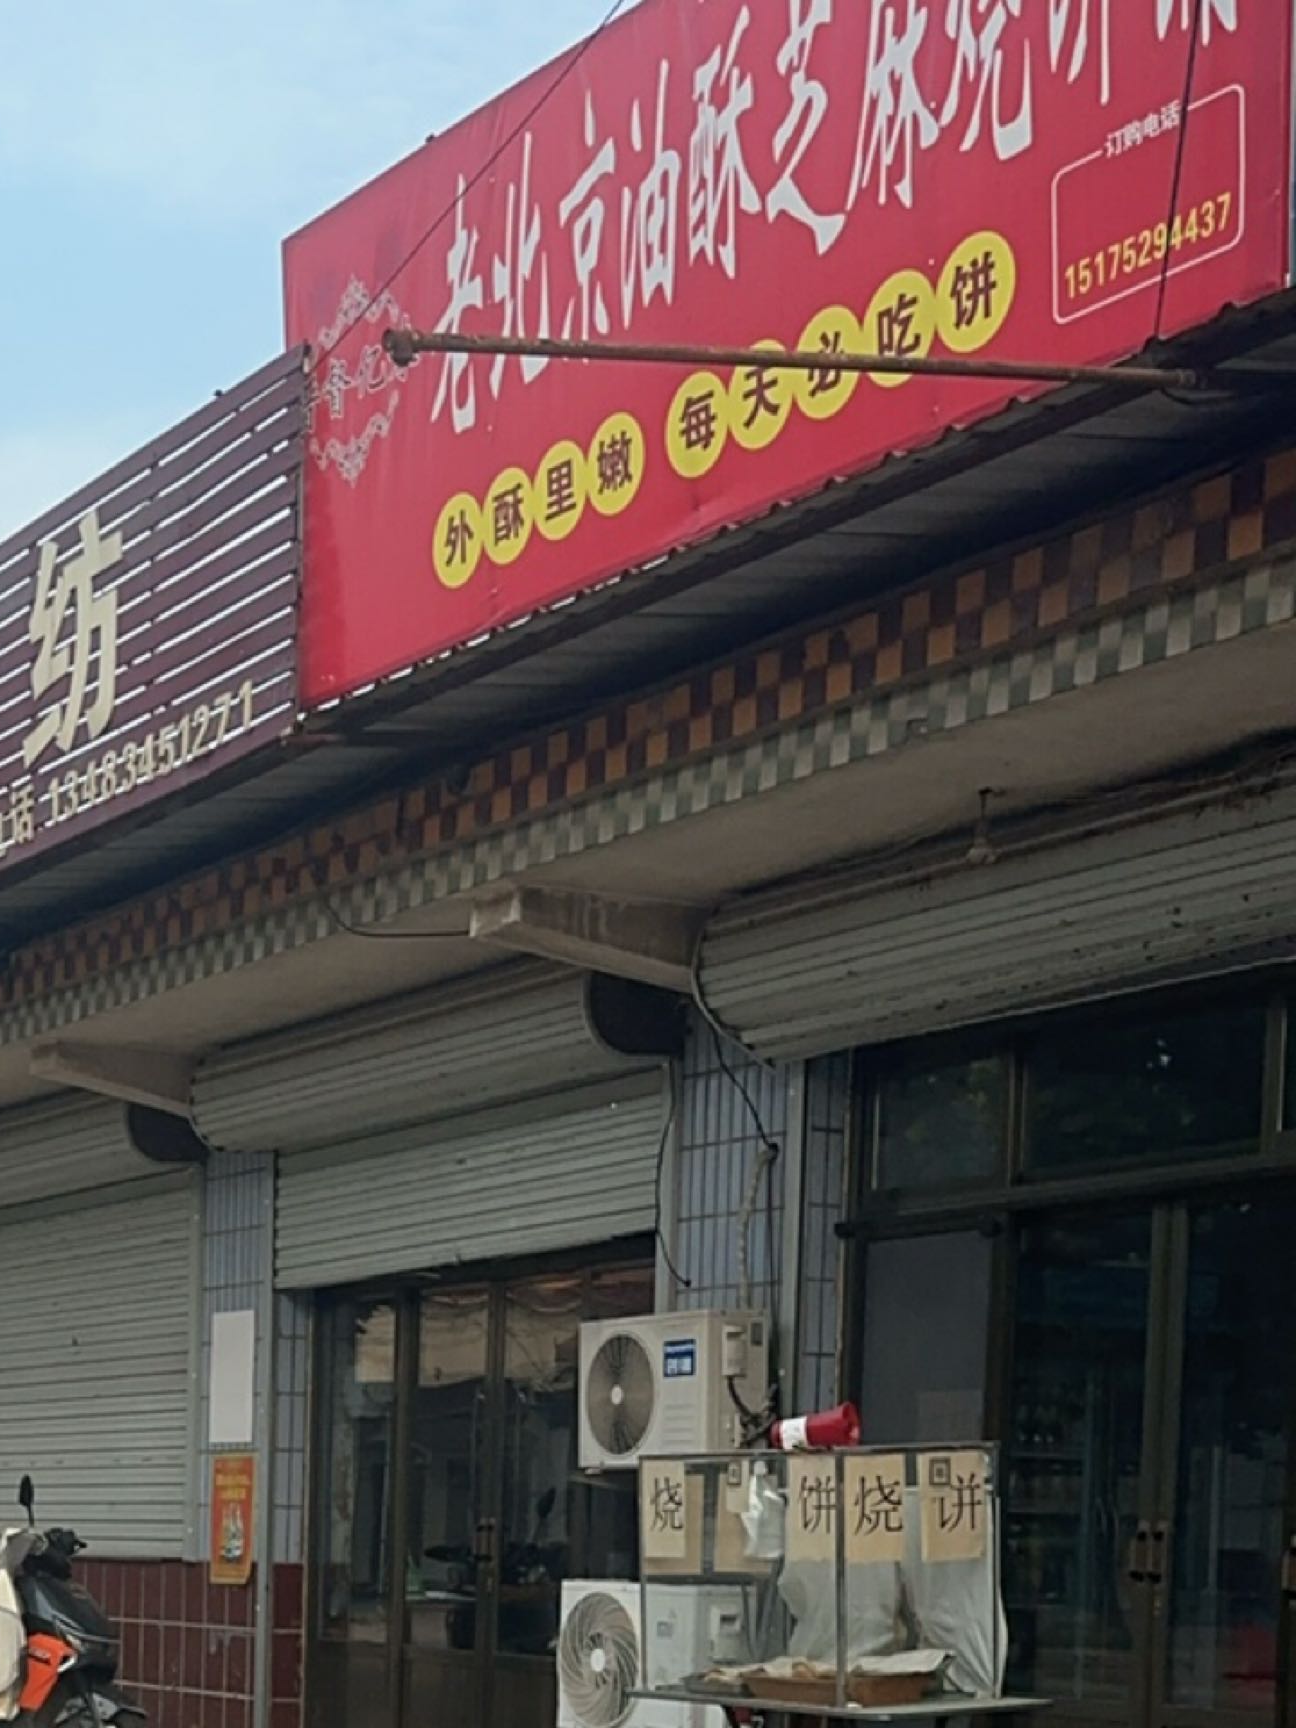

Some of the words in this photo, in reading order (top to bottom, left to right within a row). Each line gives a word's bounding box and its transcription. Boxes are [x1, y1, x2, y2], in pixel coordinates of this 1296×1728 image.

[1104, 100, 1181, 158] 订购电话
[428, 0, 1236, 434] 老北京油酥芝麻烧
[1065, 191, 1232, 299] 15175294437
[444, 430, 634, 566] 外酥里嫩
[679, 250, 998, 453] 每天必吃饼
[48, 679, 254, 826] 13483451271
[651, 1476, 684, 1532] 烧
[799, 1475, 836, 1534] 饼
